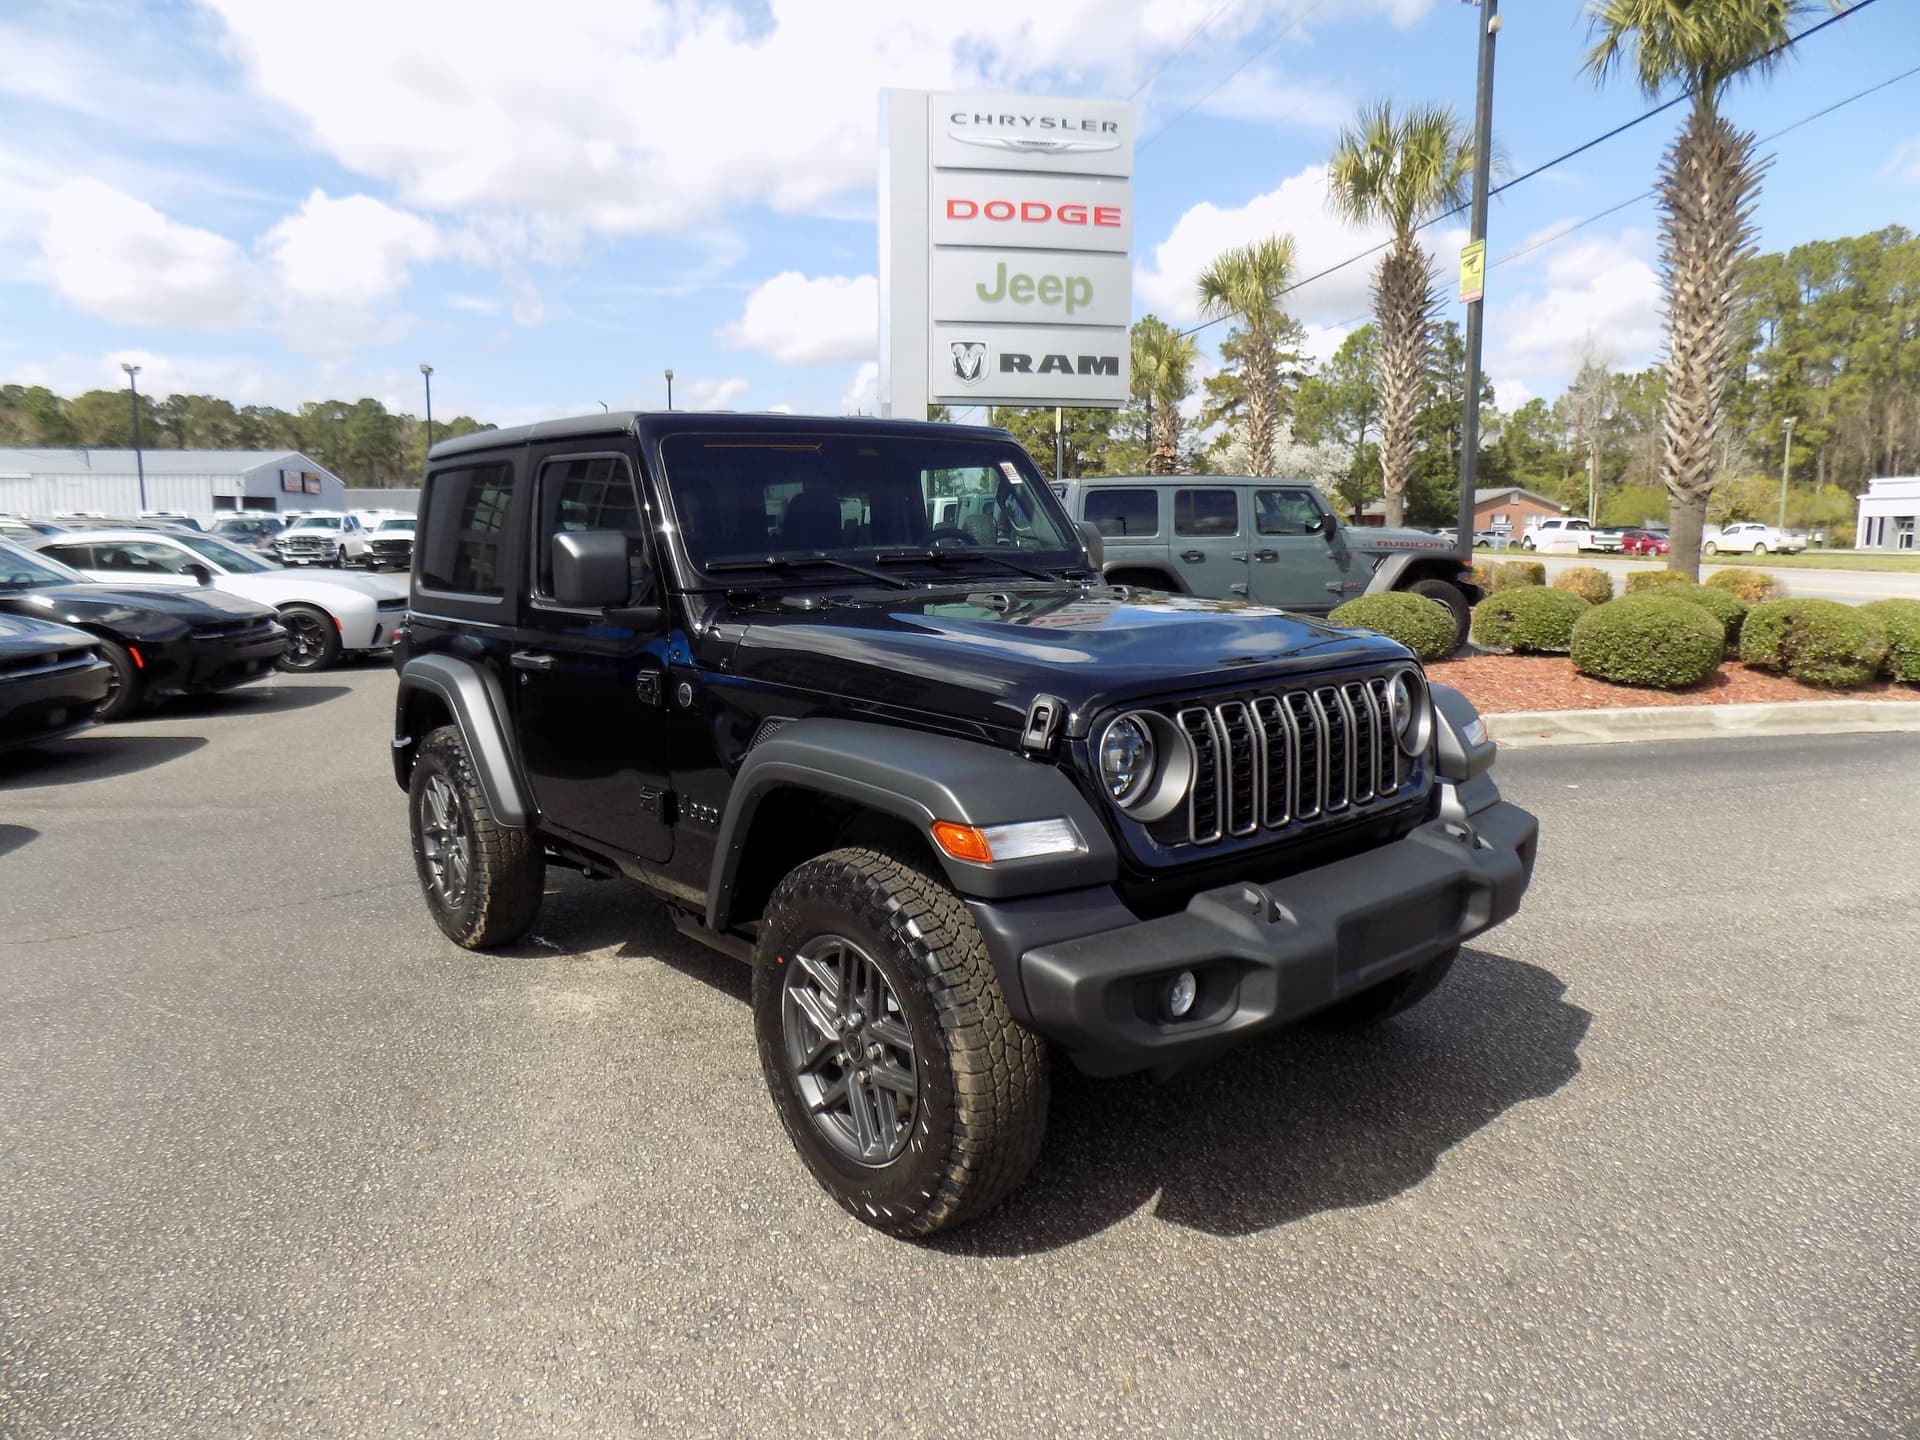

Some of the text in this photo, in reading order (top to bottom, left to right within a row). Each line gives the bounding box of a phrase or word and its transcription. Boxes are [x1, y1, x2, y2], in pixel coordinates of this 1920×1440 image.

[950, 112, 1119, 134] CHRYSLER
[946, 199, 1122, 228] DODGE
[975, 261, 1094, 315] Jeep
[999, 353, 1120, 376] RAM
[1376, 540, 1445, 550] RUBICON
